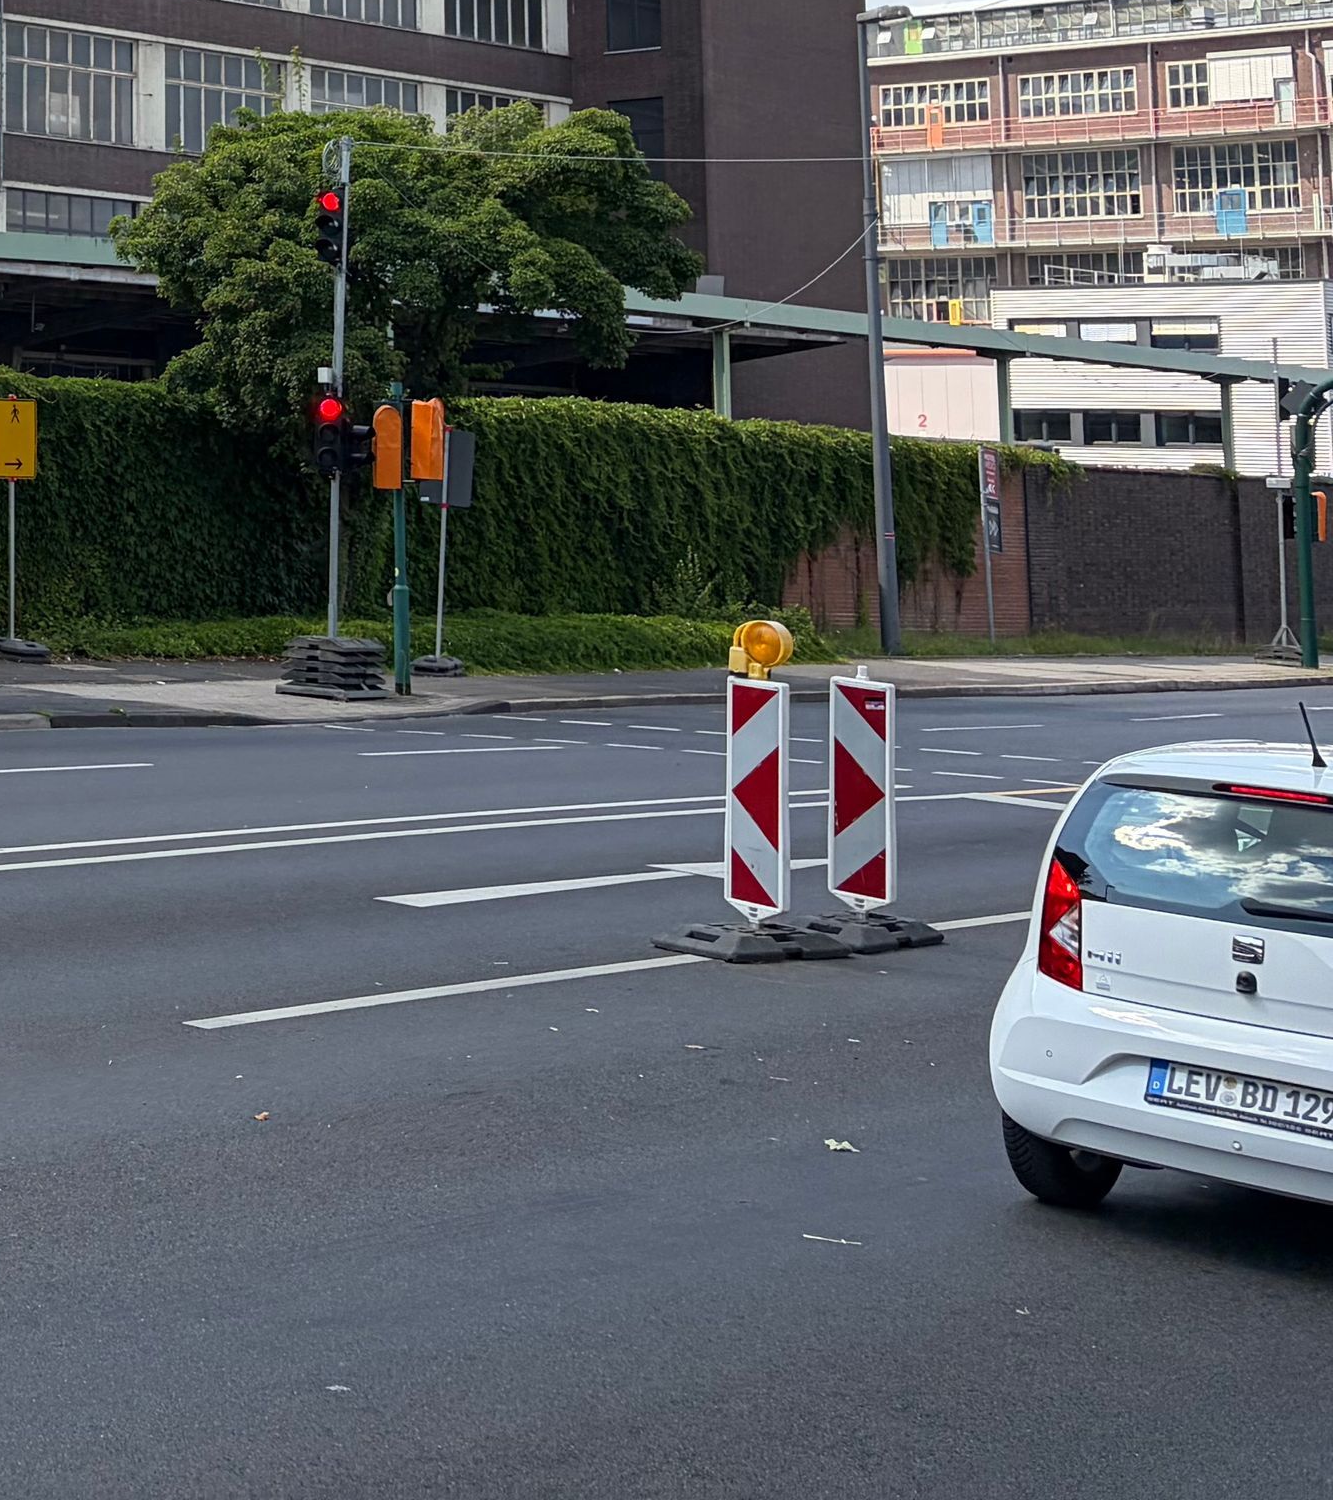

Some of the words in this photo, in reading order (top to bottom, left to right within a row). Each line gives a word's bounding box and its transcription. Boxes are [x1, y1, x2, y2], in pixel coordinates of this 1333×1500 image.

[917, 414, 927, 428] 2
[1152, 1080, 1160, 1090] D
[1166, 1066, 1222, 1102] LEV
[1240, 1080, 1279, 1113] BD
